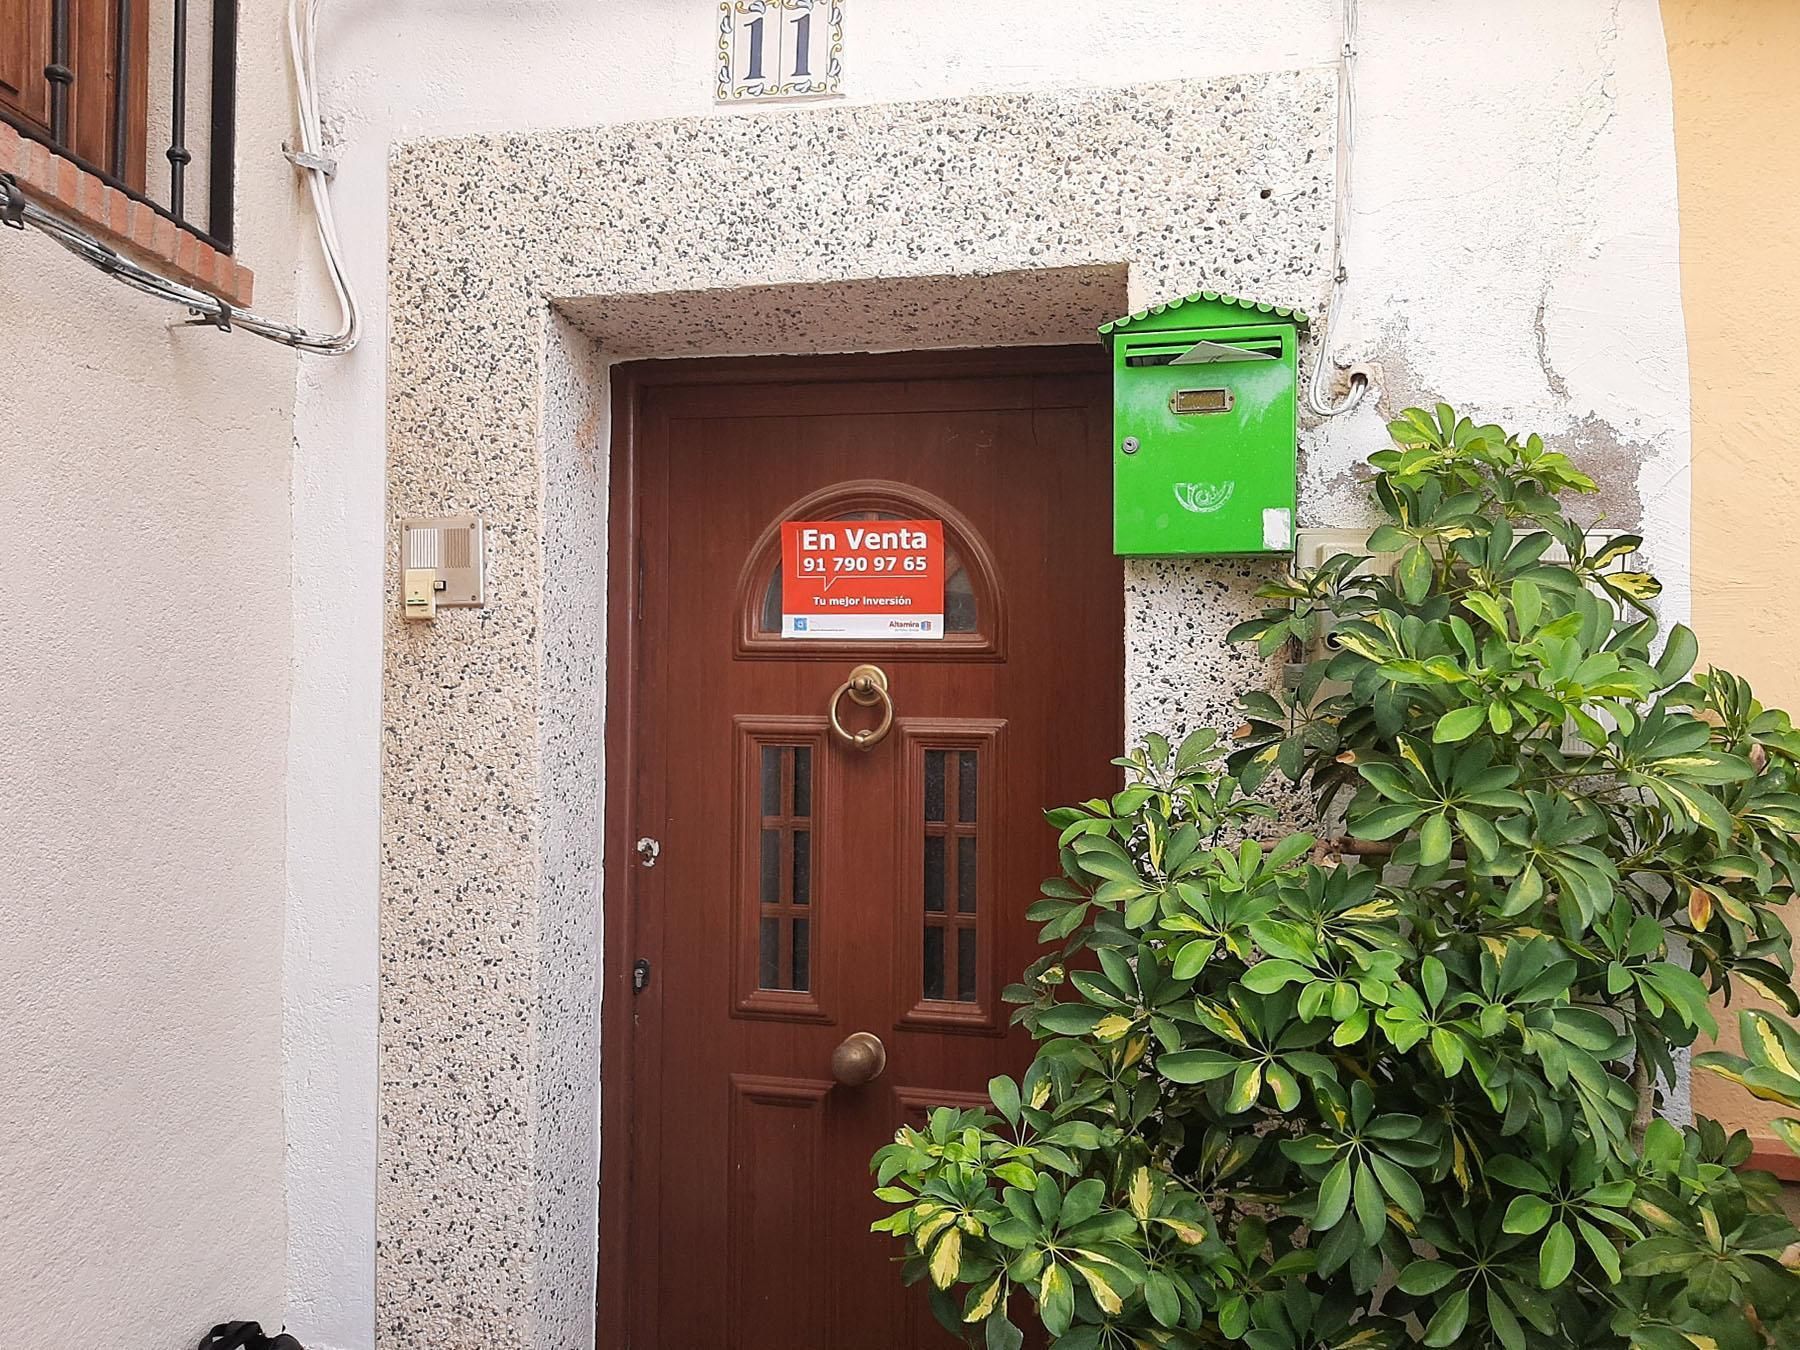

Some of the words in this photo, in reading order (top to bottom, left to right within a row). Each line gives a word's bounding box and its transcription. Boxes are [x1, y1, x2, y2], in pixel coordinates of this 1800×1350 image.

[743, 13, 811, 80] 11
[802, 529, 836, 550] En
[845, 528, 927, 550] Venta
[803, 557, 826, 572] 91
[832, 557, 868, 572] 790
[873, 556, 897, 571] 97
[903, 556, 927, 571] 65
[813, 596, 826, 606] Tu
[829, 596, 860, 607] mejor
[889, 620, 920, 628] Altamira
